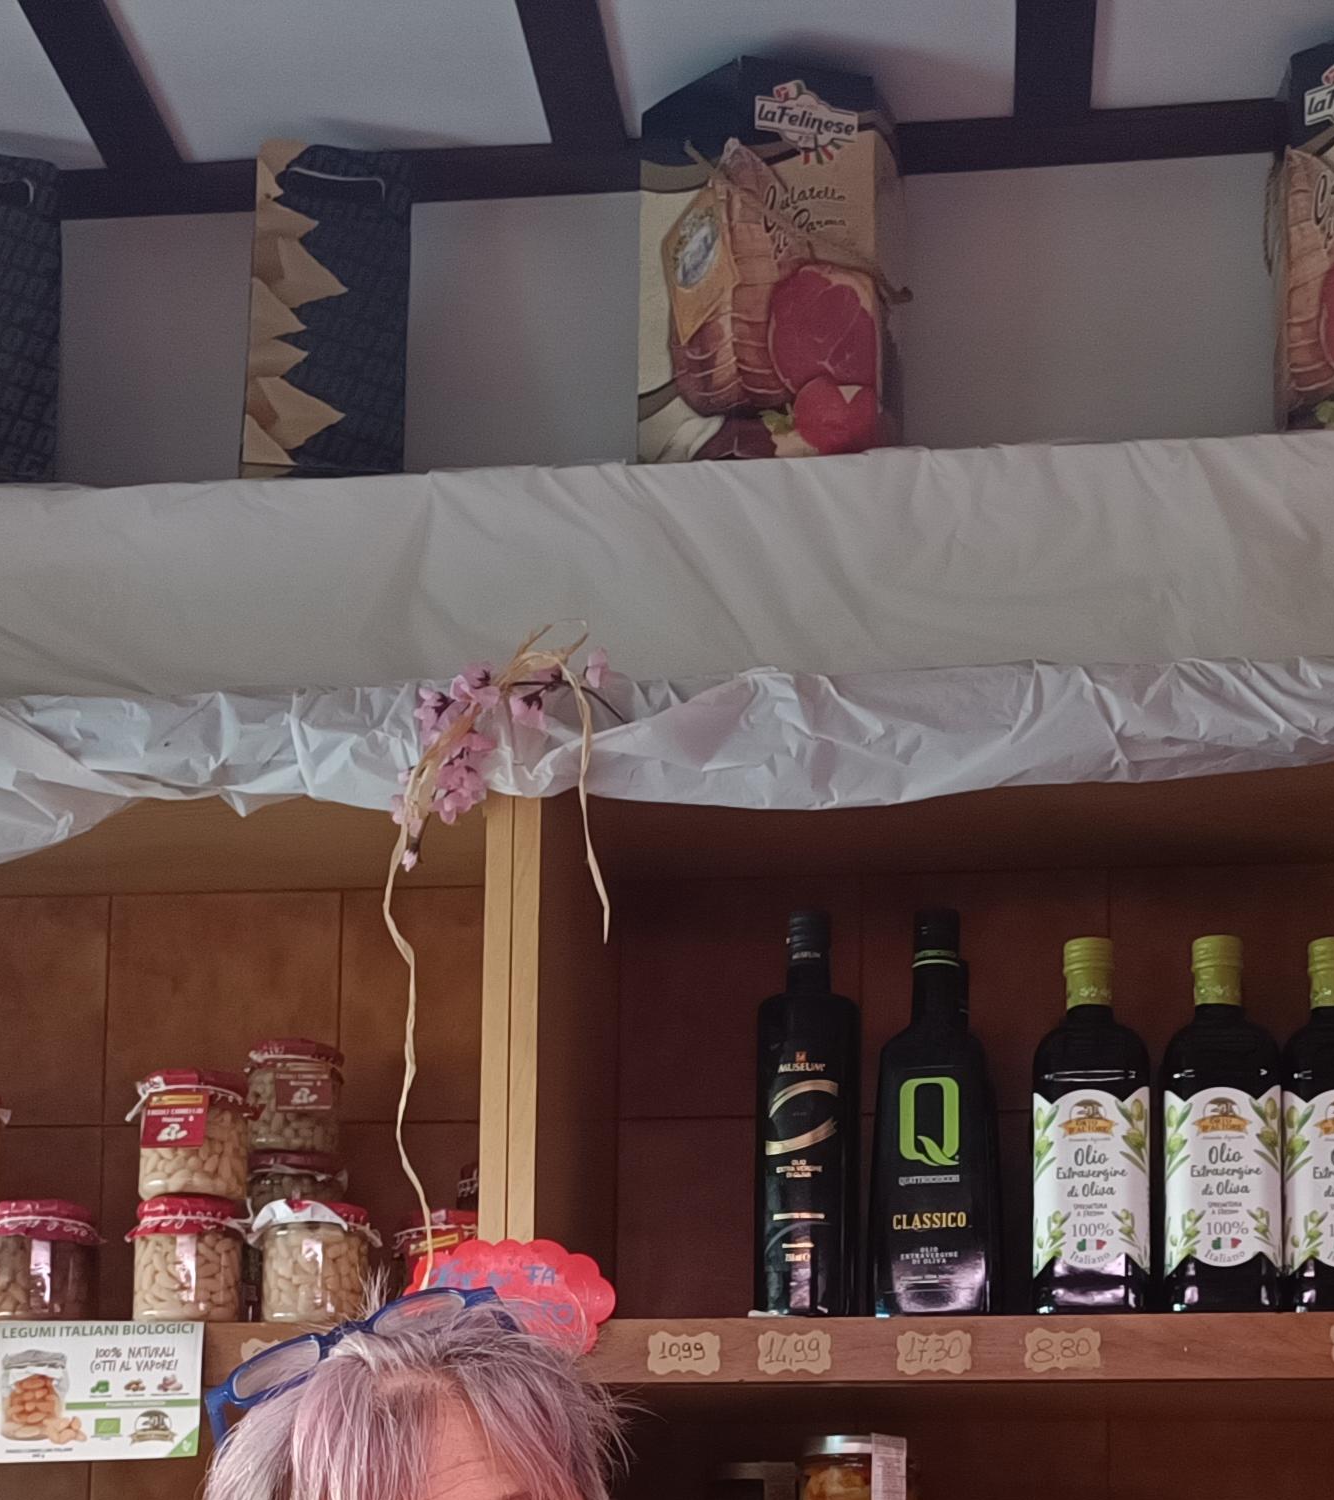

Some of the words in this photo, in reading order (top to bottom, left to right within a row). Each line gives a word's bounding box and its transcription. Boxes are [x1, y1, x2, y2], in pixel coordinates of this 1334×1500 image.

[1074, 1145, 1109, 1166] Olio
[1208, 1143, 1243, 1164] Olio
[1082, 1182, 1116, 1197] Oliva
[1216, 1179, 1250, 1195] Oliva
[892, 1211, 967, 1230] CLASSICO
[1206, 1221, 1249, 1236] 100%
[1072, 1223, 1114, 1237] 100%
[2, 1327, 56, 1339] LEGUMI
[59, 1325, 118, 1337] ITALIANI
[123, 1323, 195, 1336] BIOLOGICI
[127, 1346, 175, 1358] NATURALI
[657, 1341, 706, 1361] 10,99
